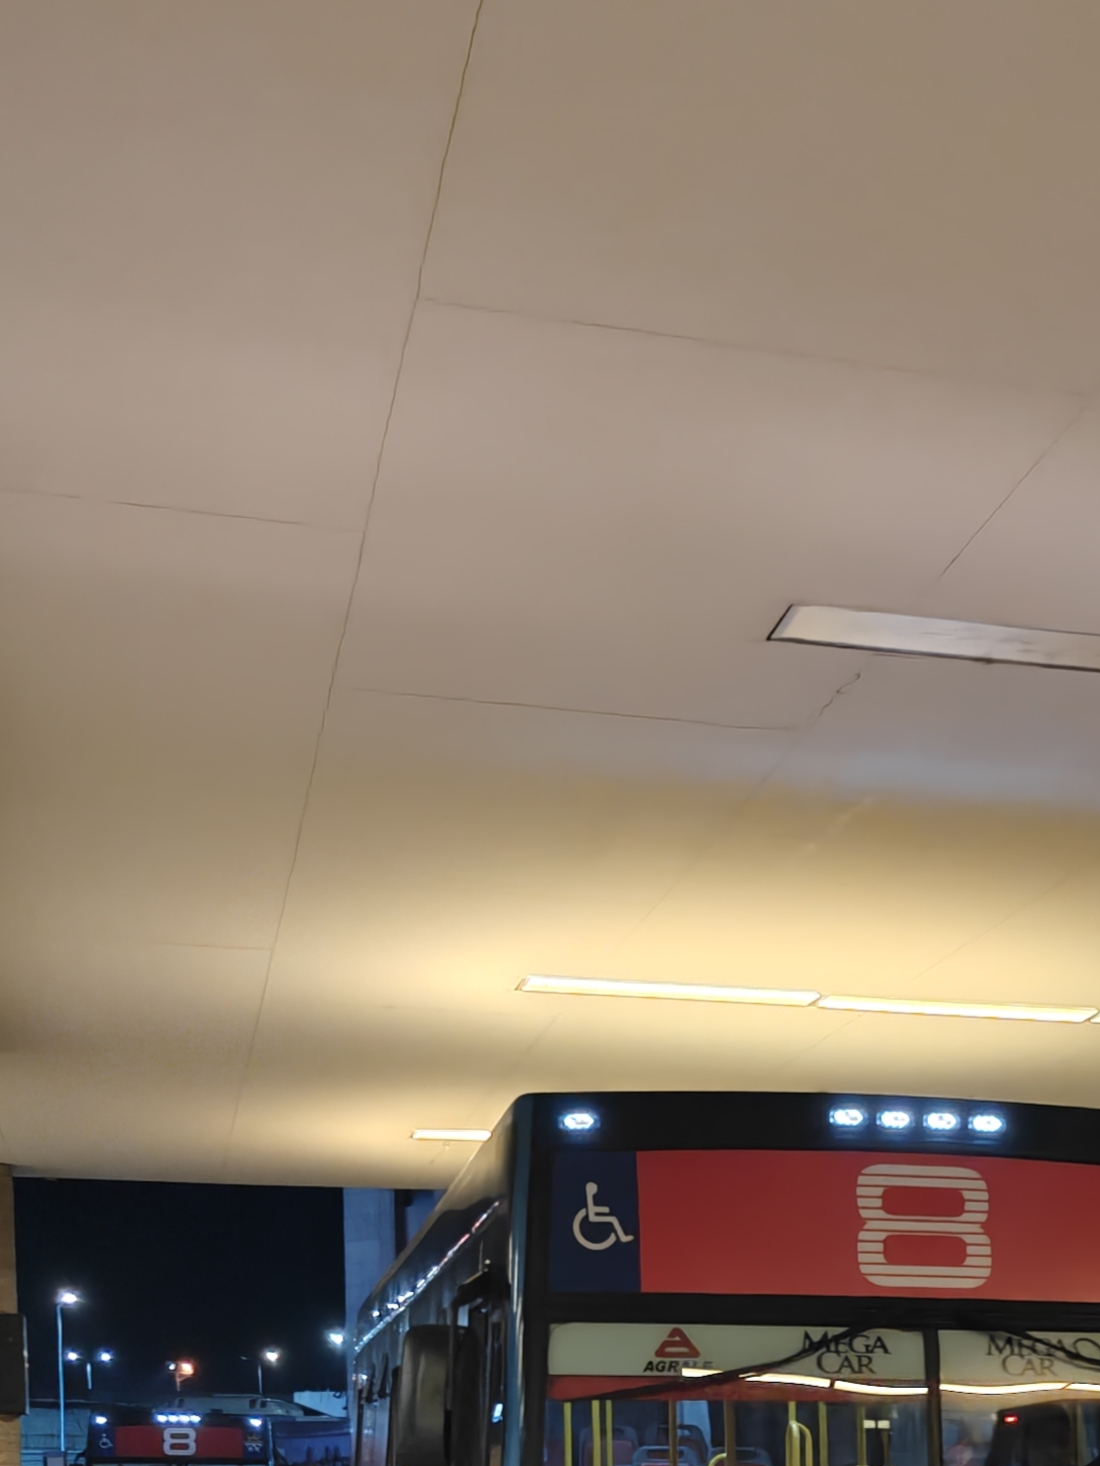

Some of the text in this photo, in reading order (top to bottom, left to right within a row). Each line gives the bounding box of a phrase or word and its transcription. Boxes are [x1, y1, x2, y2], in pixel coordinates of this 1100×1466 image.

[856, 1163, 992, 1289] 8
[816, 1355, 876, 1374] CAR
[1001, 1354, 1058, 1377] CAR
[163, 1427, 196, 1456] 8
